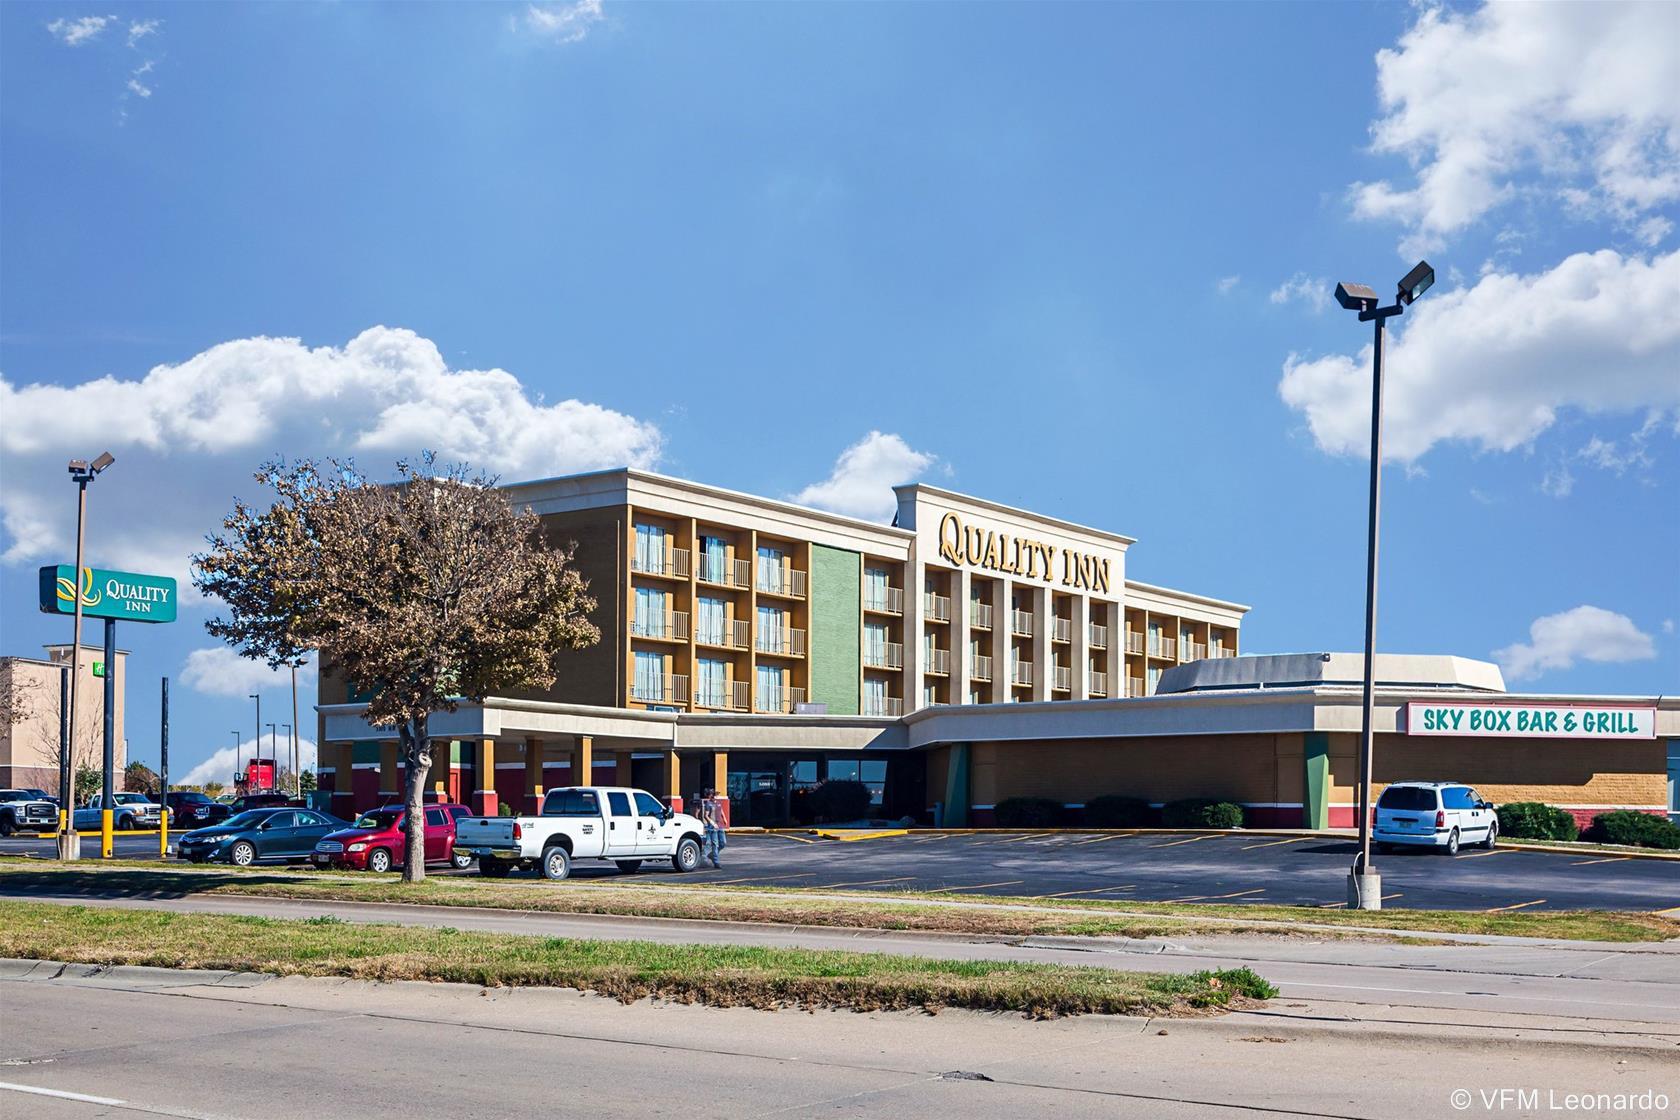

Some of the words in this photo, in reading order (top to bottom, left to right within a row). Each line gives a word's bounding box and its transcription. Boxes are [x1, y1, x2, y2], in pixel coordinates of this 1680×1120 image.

[939, 512, 1057, 582] QUALITY
[1062, 549, 1112, 594] INN
[106, 579, 170, 603] QUALITY
[125, 600, 151, 613] INN
[1423, 708, 1464, 731] SKY
[1470, 709, 1511, 732] BOX
[1517, 711, 1558, 732] BAR
[1563, 712, 1578, 733] &
[1583, 712, 1639, 734] GRILL
